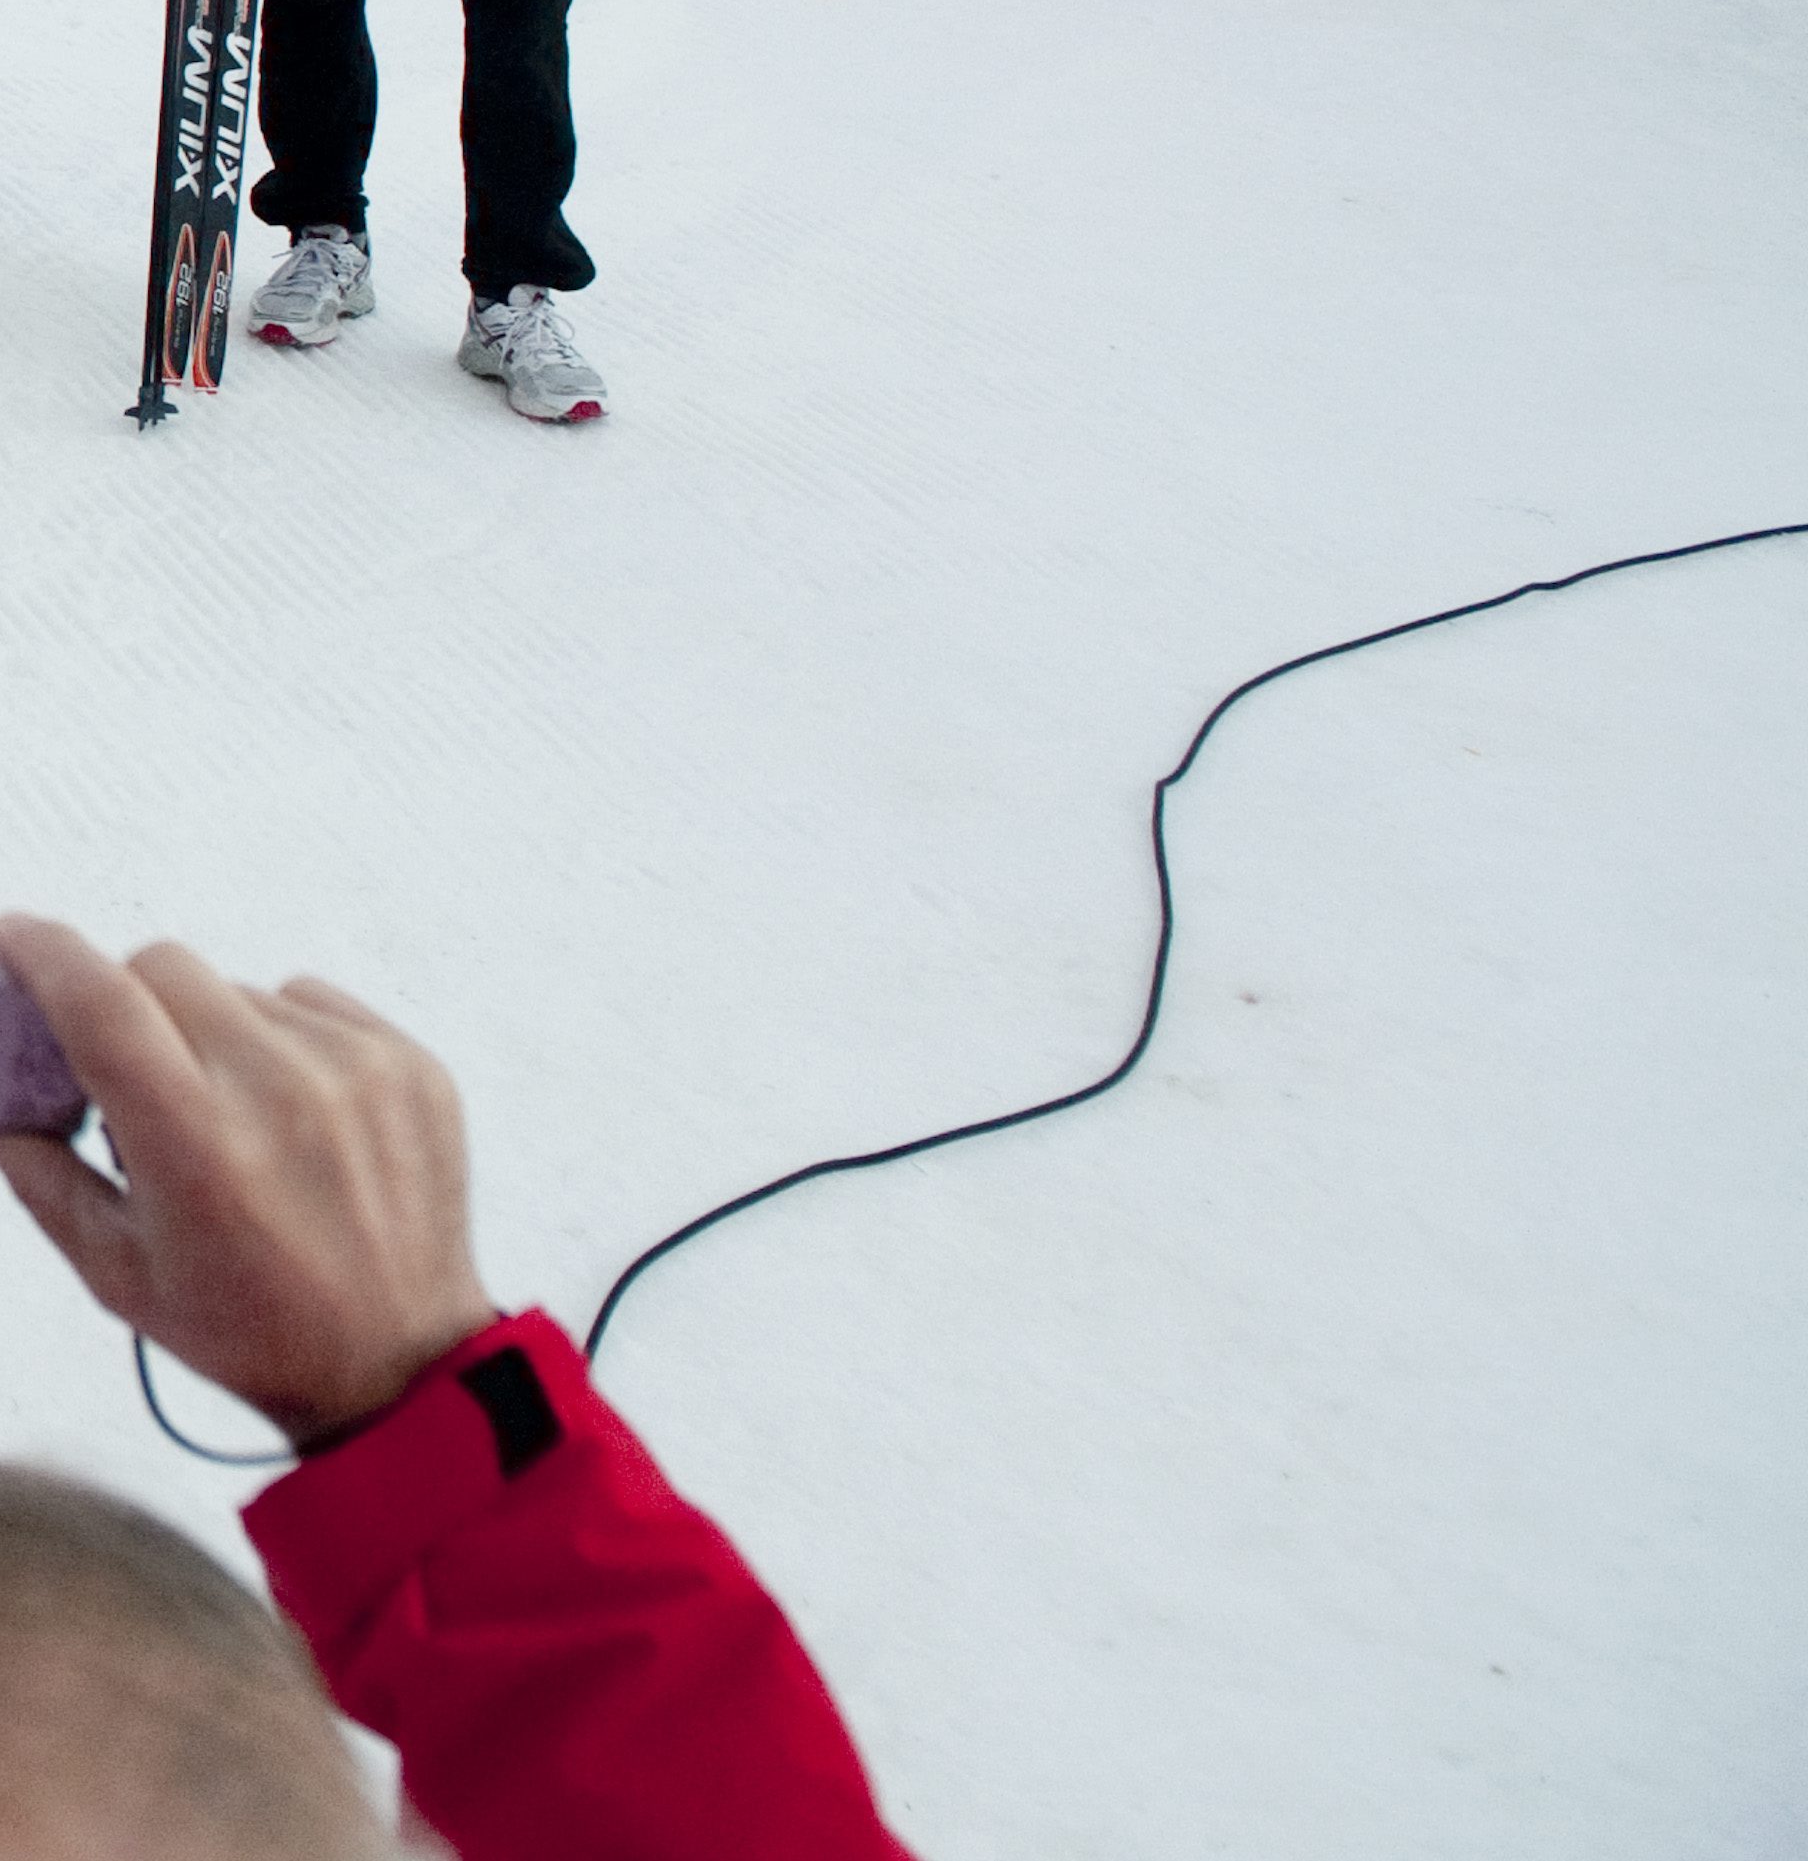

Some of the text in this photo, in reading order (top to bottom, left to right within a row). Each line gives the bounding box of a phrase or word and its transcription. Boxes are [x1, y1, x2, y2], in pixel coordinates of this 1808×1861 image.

[173, 26, 214, 199] XIUM
[211, 31, 252, 207] XIUM
[176, 262, 193, 309] 192
[213, 268, 231, 315] 192
